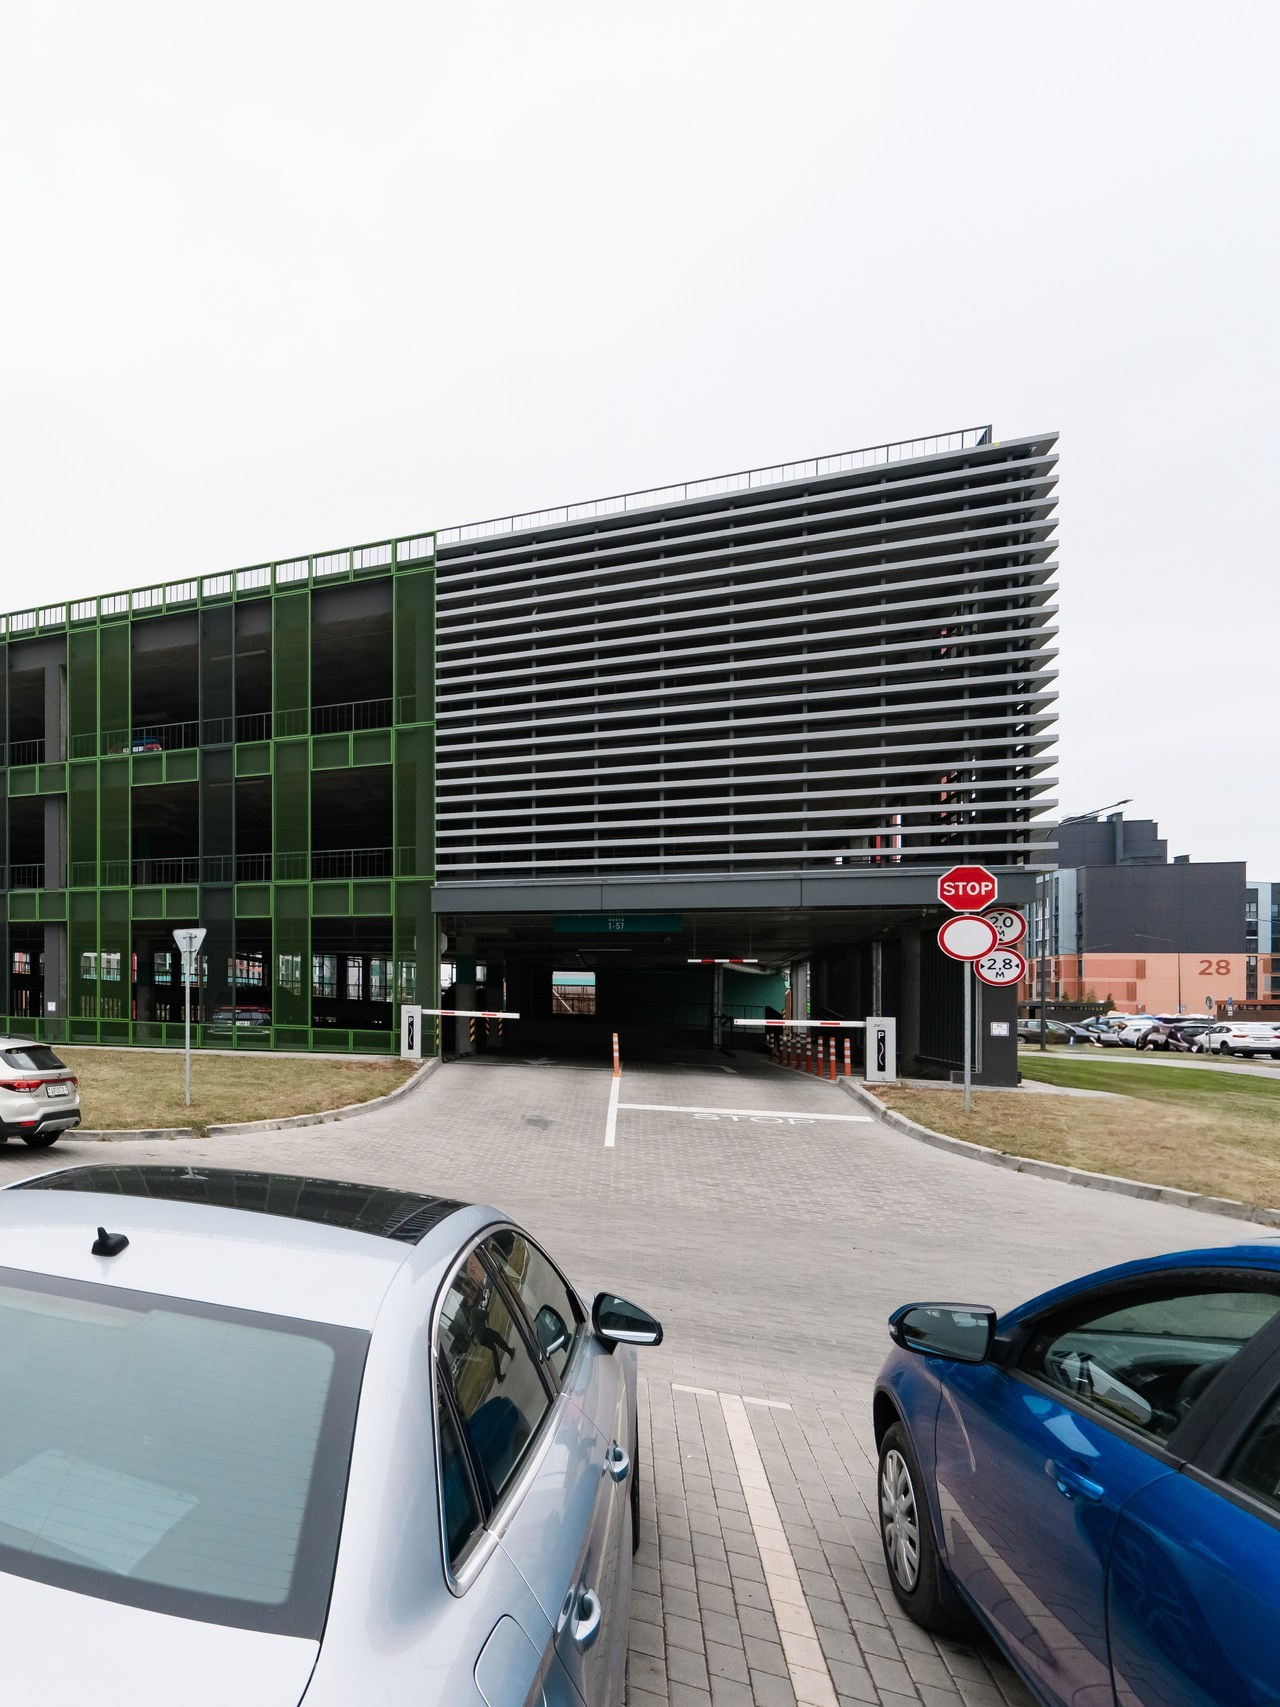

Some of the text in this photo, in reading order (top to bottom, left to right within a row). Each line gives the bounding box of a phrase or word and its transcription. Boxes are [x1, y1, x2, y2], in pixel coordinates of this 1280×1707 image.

[943, 881, 993, 896] STOP
[986, 958, 1013, 971] 2,8
[1198, 959, 1231, 976] 28
[877, 1031, 885, 1040] P
[693, 1113, 816, 1125] STOP
